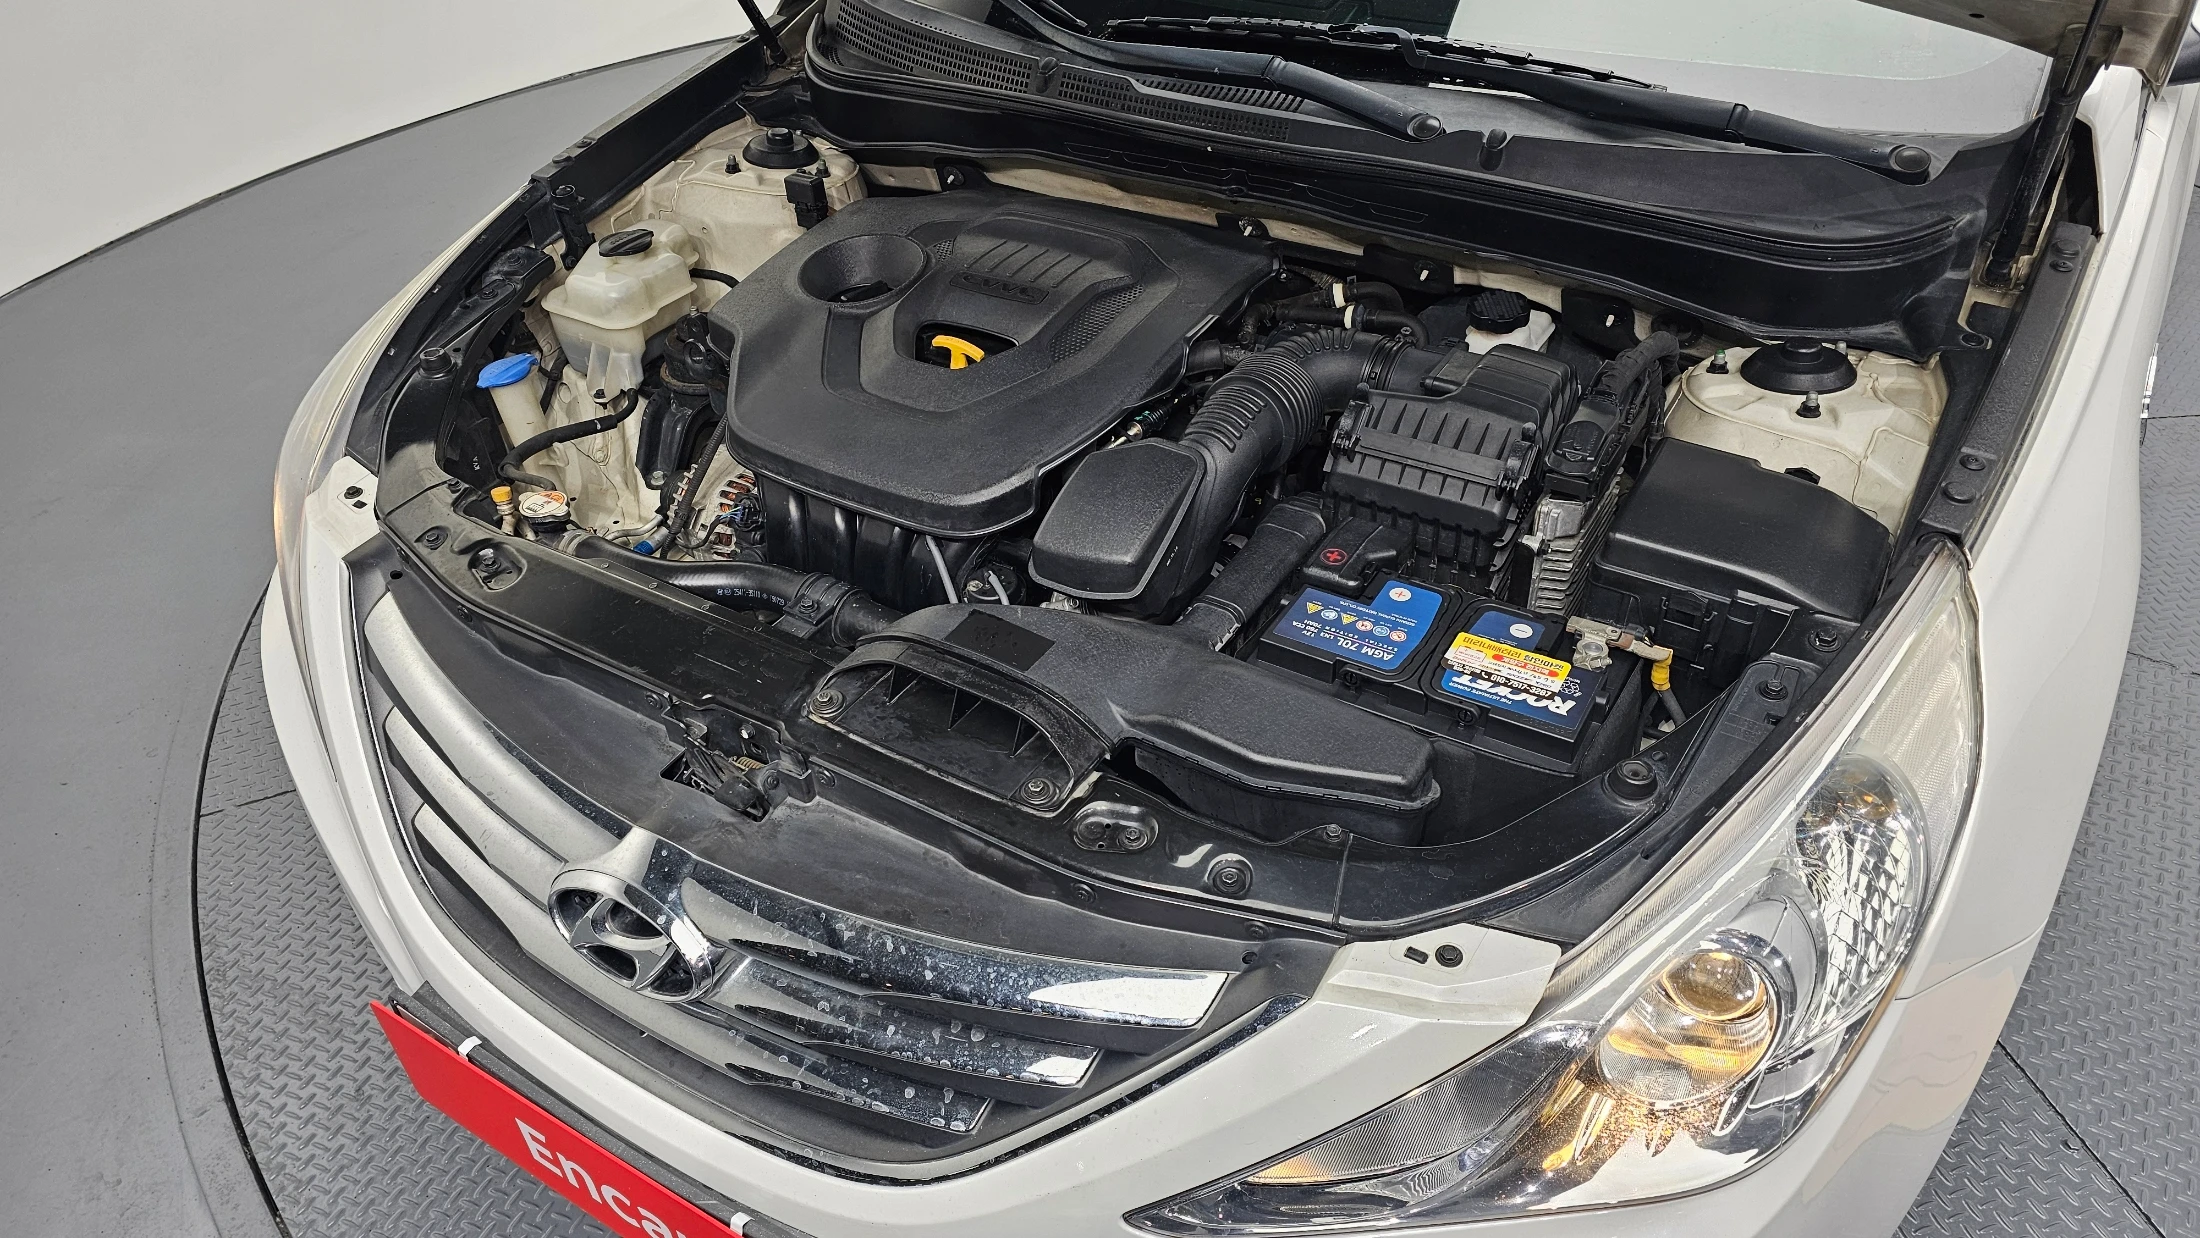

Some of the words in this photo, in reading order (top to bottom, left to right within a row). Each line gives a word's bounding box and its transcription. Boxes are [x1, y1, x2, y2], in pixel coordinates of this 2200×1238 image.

[1336, 637, 1360, 651] 70L
[1361, 645, 1394, 660] AGM
[1490, 674, 1552, 697] 010-7517-3287
[515, 1117, 690, 1238] Enca
